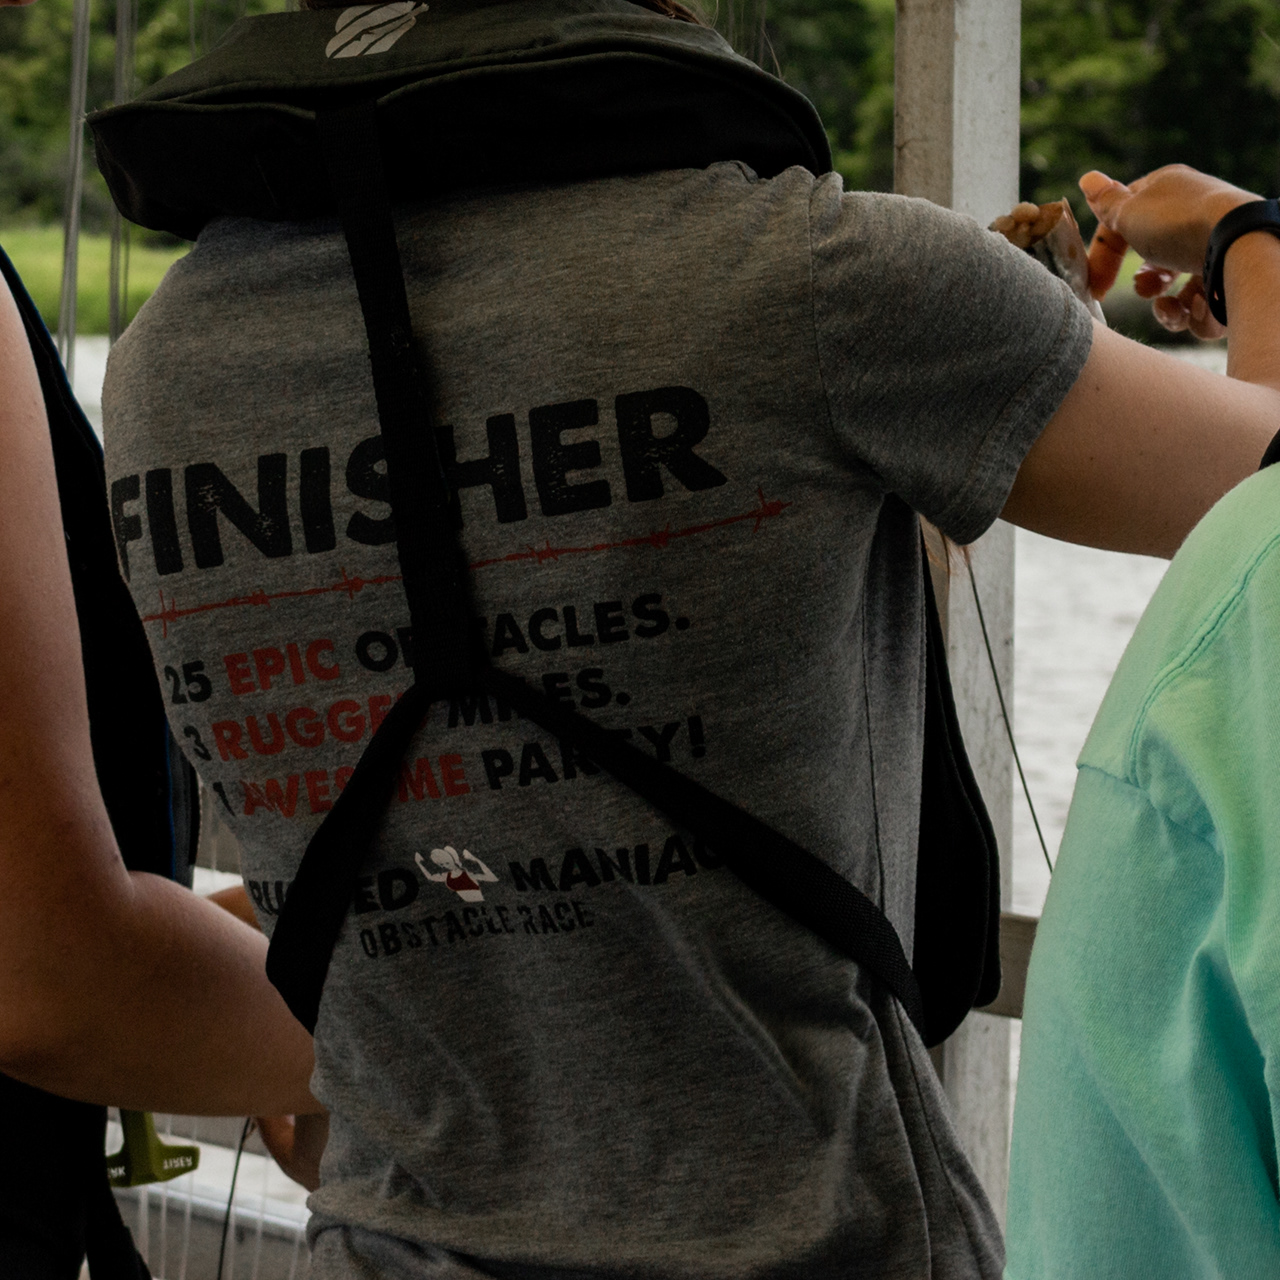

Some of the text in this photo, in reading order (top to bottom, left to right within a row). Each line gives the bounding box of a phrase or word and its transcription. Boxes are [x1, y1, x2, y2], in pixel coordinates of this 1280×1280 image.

[110, 385, 728, 584] FINISHER
[164, 592, 690, 705] 25 EPIC OACLES.
[183, 668, 632, 763] 3 RUGGE MIES.
[239, 753, 472, 818] AWEME
[481, 714, 707, 790] PARY!
[248, 867, 421, 916] RUED
[359, 900, 595, 960] OBSTACLE RACE
